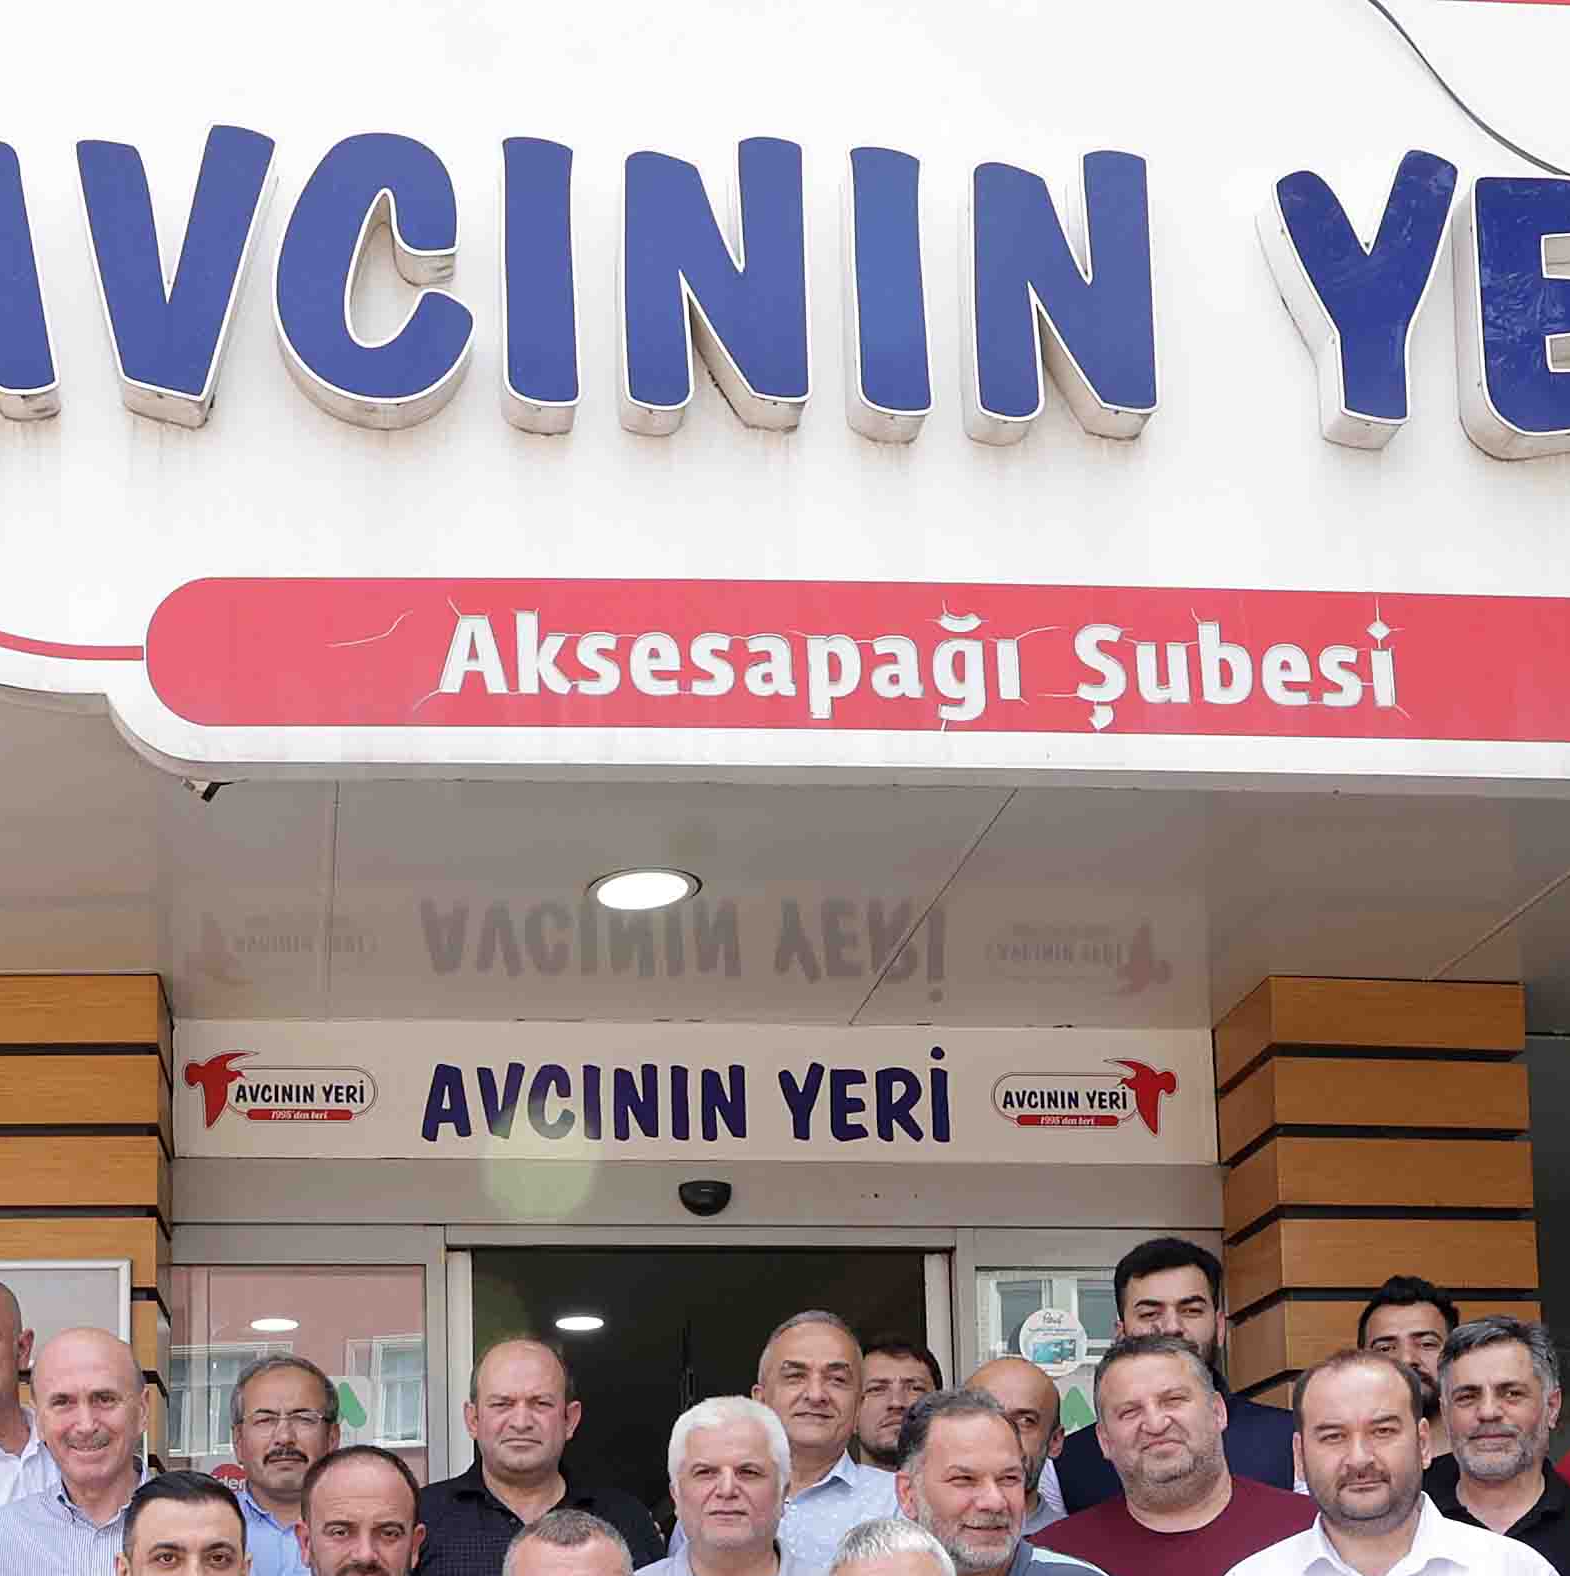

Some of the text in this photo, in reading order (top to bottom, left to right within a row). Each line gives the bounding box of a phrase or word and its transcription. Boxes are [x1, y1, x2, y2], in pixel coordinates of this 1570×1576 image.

[438, 608, 1397, 731] Aksesapağı Şubesi
[234, 1080, 365, 1103] AVCININ YERİ
[420, 1045, 952, 1144] AVCININ YERİ
[1002, 1086, 1127, 1110] AVCININ YERİ
